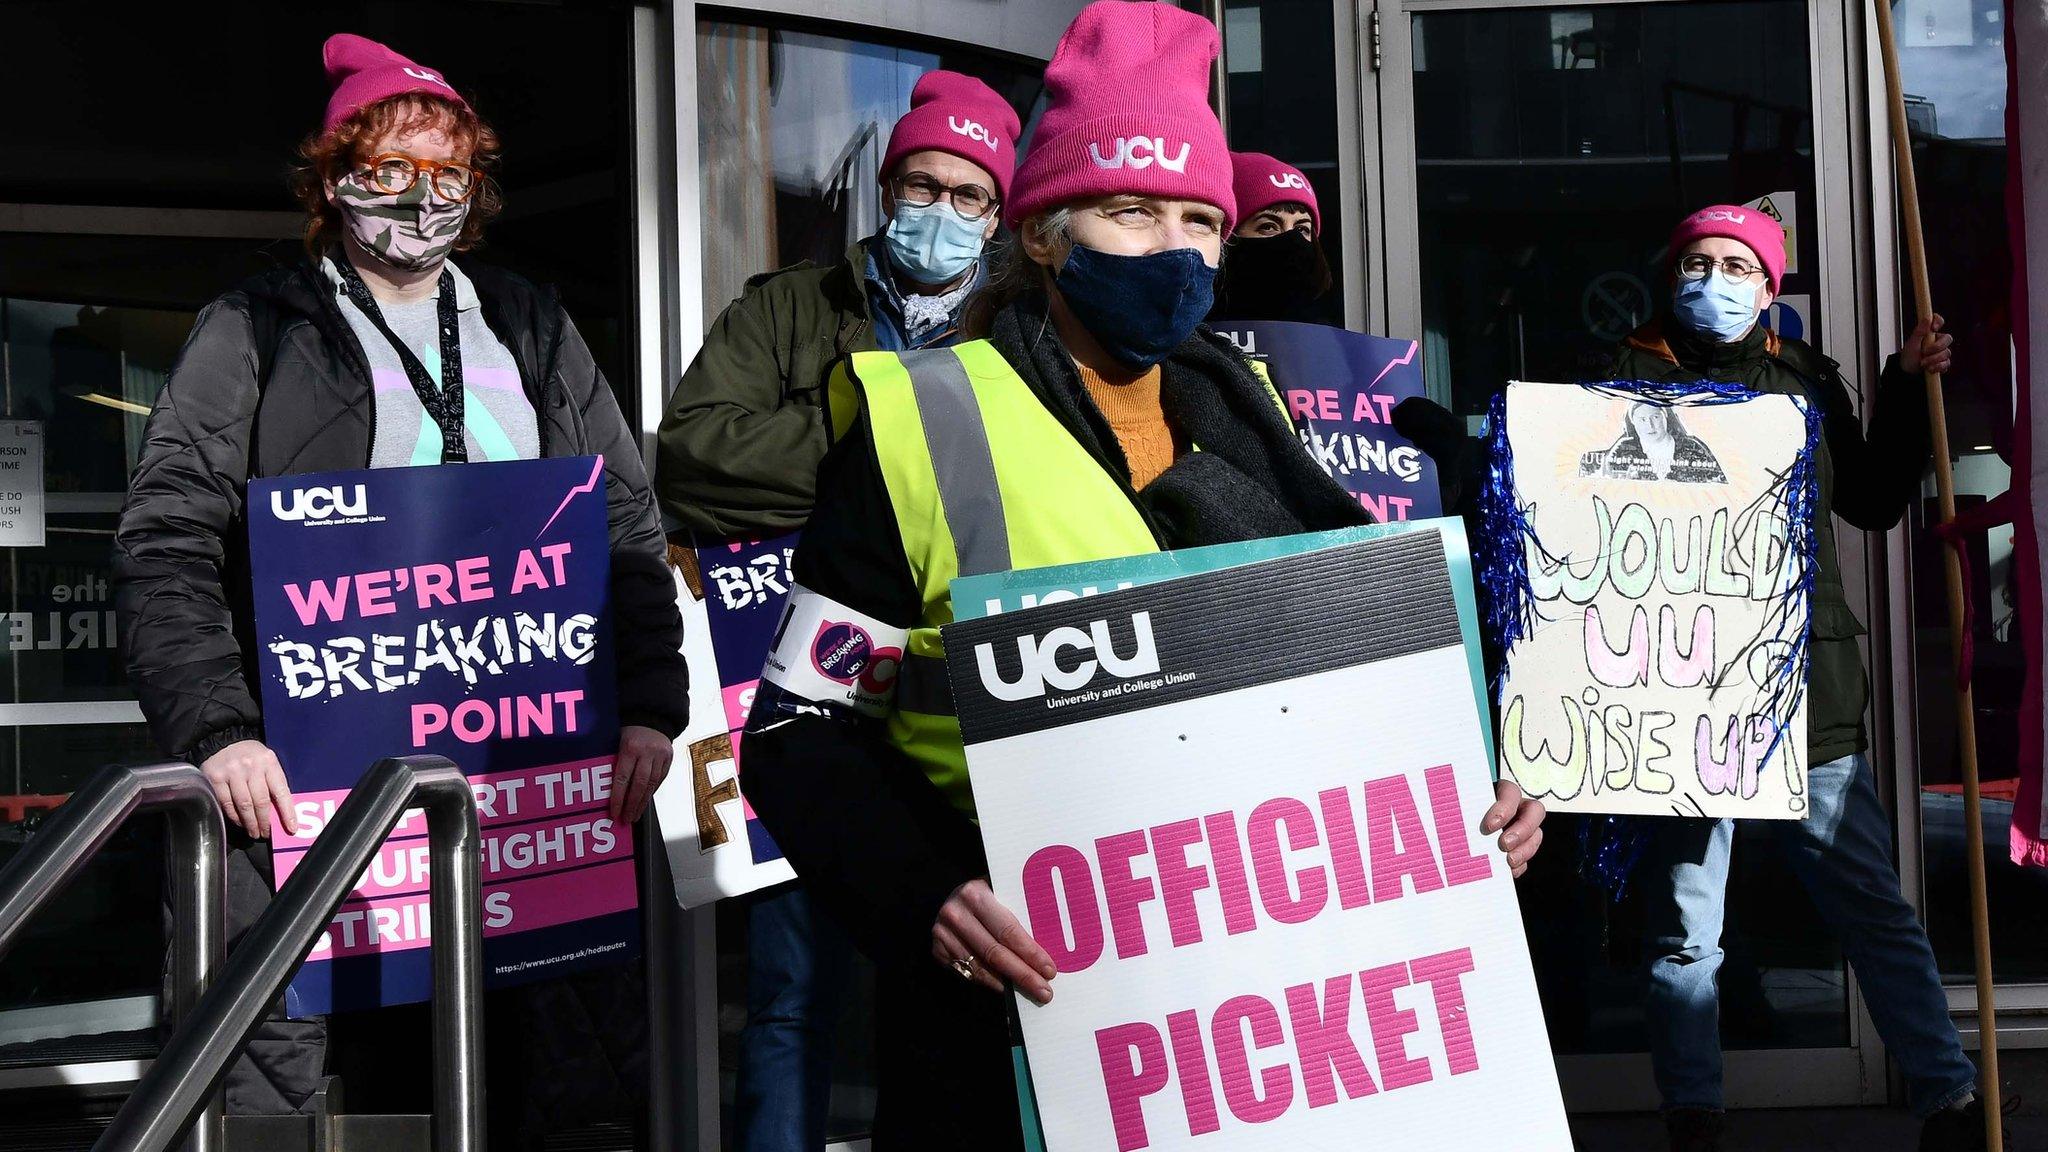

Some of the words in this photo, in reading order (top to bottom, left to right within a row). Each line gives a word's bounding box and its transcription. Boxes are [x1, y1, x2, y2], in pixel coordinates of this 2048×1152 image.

[1088, 135, 1190, 174] UCU
[1353, 393, 1395, 424] AT
[7, 492, 22, 501] DO
[271, 484, 368, 521] UCU
[304, 519, 333, 527] University
[510, 542, 572, 594] AT
[1524, 495, 1802, 605] WOULD
[268, 611, 598, 700] BREAKING
[821, 633, 864, 670] BREAKING
[975, 611, 1161, 701] UCU
[1047, 691, 1100, 709] University
[1102, 685, 1121, 699] and
[1123, 675, 1164, 693] College
[1165, 671, 1196, 685] Union
[411, 690, 585, 747] POINT
[535, 764, 613, 809] THE
[1022, 763, 1493, 974] OFFICIAL
[495, 941, 626, 974] https://www.ucu.org.uk/hedisputes
[1095, 947, 1479, 1152] PICKET
